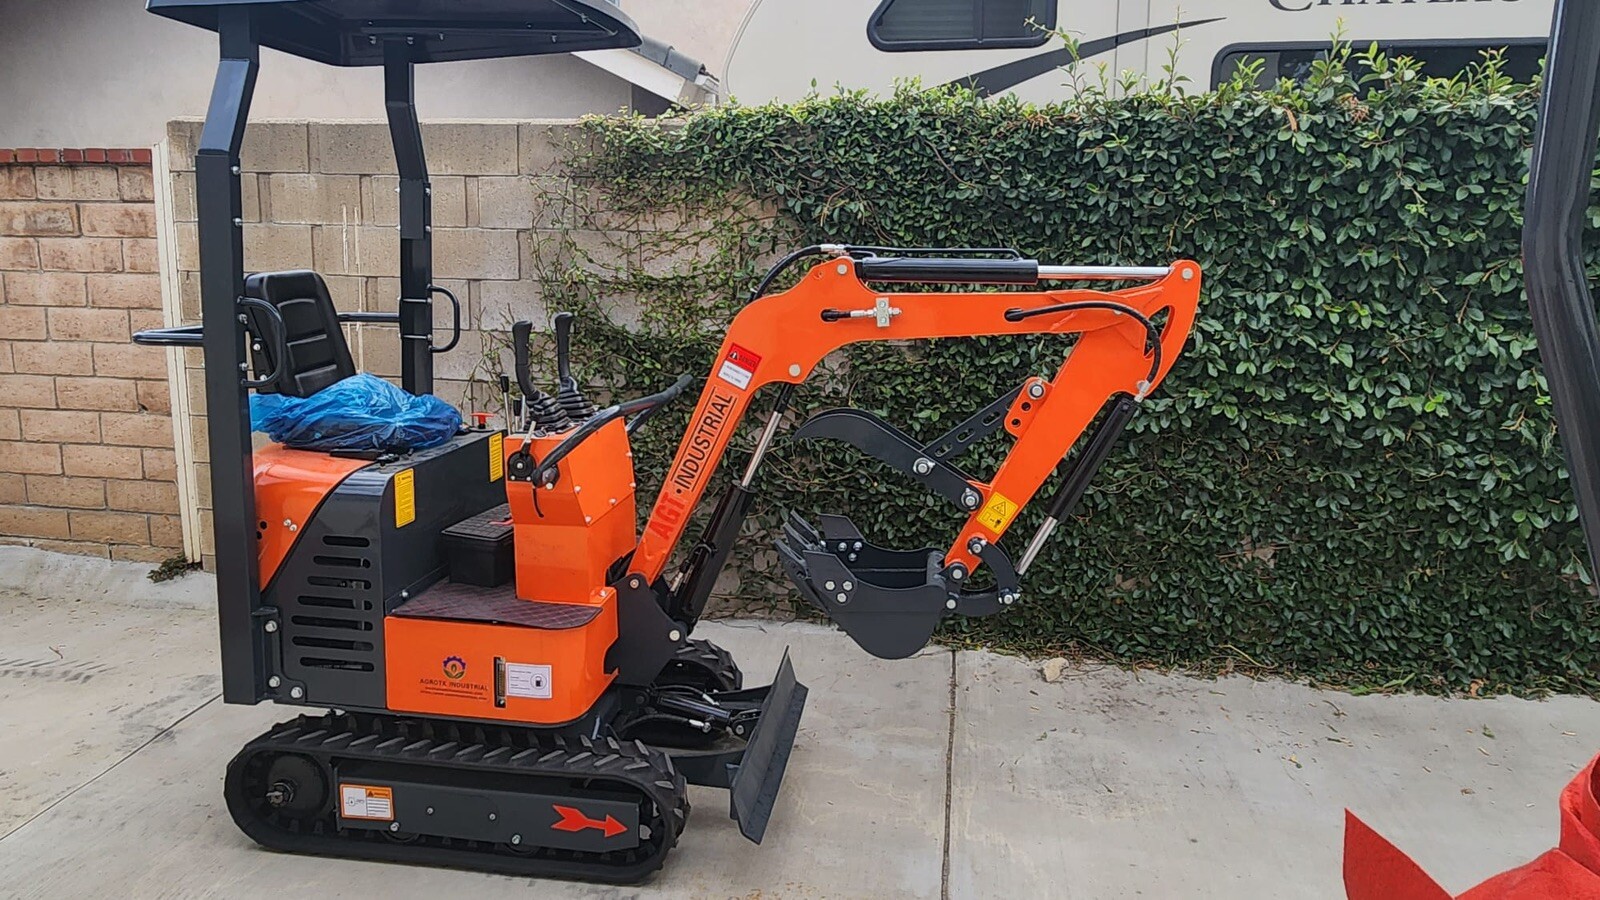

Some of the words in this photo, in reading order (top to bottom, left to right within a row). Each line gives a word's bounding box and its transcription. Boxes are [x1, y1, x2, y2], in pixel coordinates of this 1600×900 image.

[650, 492, 685, 540] AGT
[674, 394, 733, 490] INDUSTRIAL
[449, 681, 488, 691] INDUSTRIAL
